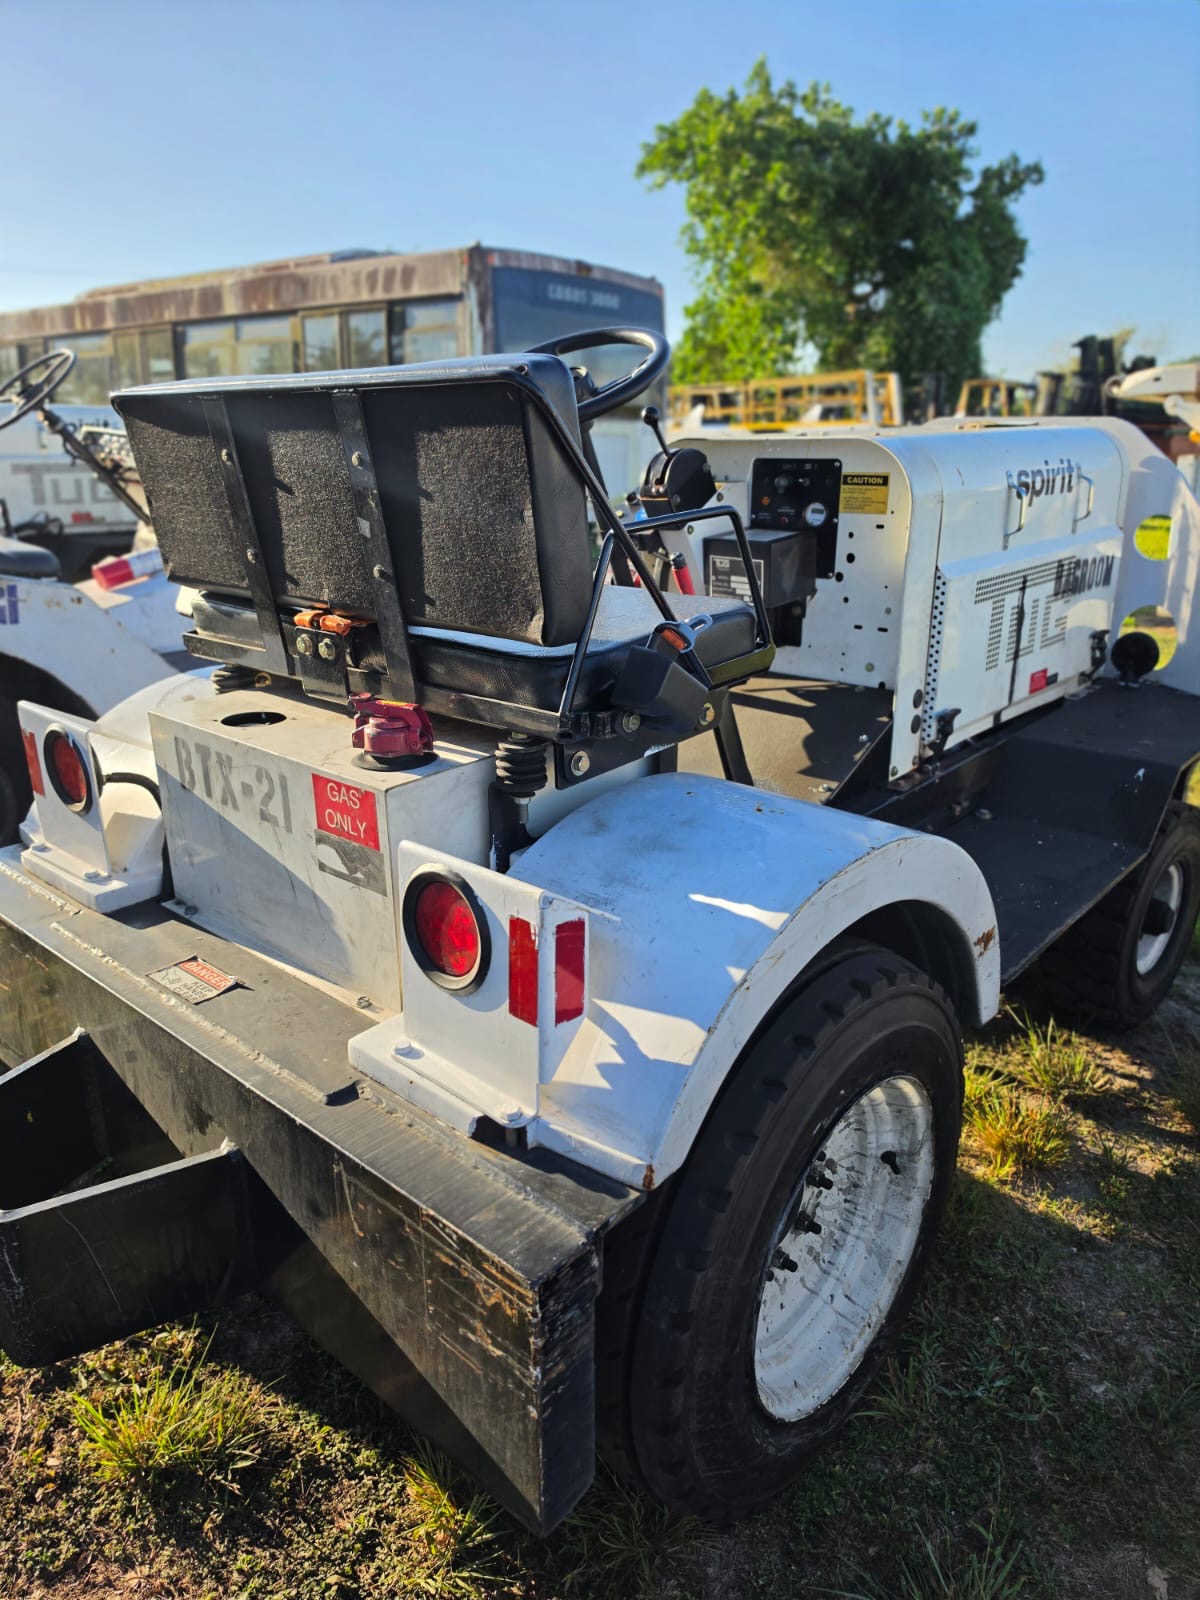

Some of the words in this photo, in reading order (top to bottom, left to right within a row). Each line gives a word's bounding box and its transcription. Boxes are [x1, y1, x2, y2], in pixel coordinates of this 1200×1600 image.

[847, 475, 884, 485] CAUTION
[1016, 458, 1074, 507] spirit
[975, 556, 1076, 672] TUG
[174, 735, 293, 834] BTX-21
[327, 782, 361, 809] GAS
[325, 808, 367, 839] ONLY
[184, 961, 229, 989] DANGER
